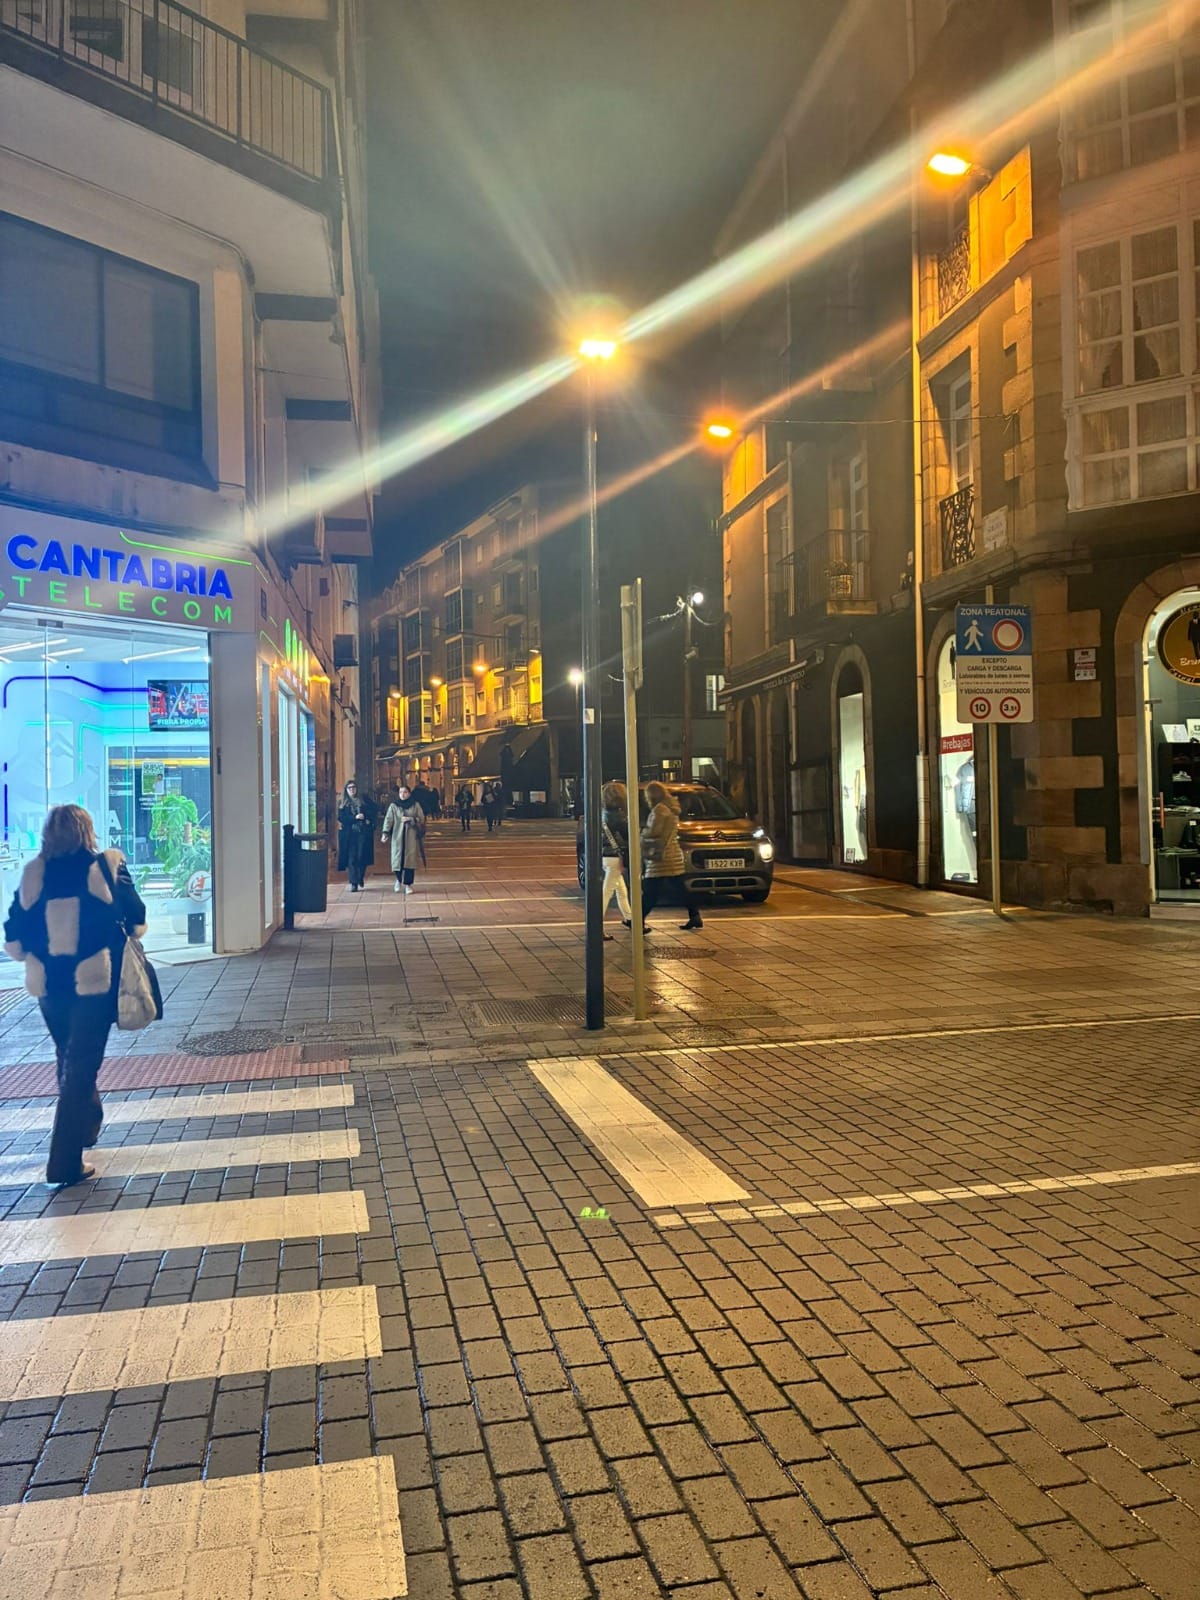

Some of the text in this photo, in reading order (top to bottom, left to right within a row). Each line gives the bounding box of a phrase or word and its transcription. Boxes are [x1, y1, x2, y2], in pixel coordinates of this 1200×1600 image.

[6, 534, 233, 600] CANTABRIA
[12, 576, 232, 624] TELECOM
[960, 607, 1026, 616] ZONA PEATONAL
[974, 703, 987, 713] 10
[157, 718, 206, 726] FIBRA PROPIA
[942, 736, 971, 751] #rebajas
[711, 860, 728, 868] 1522
